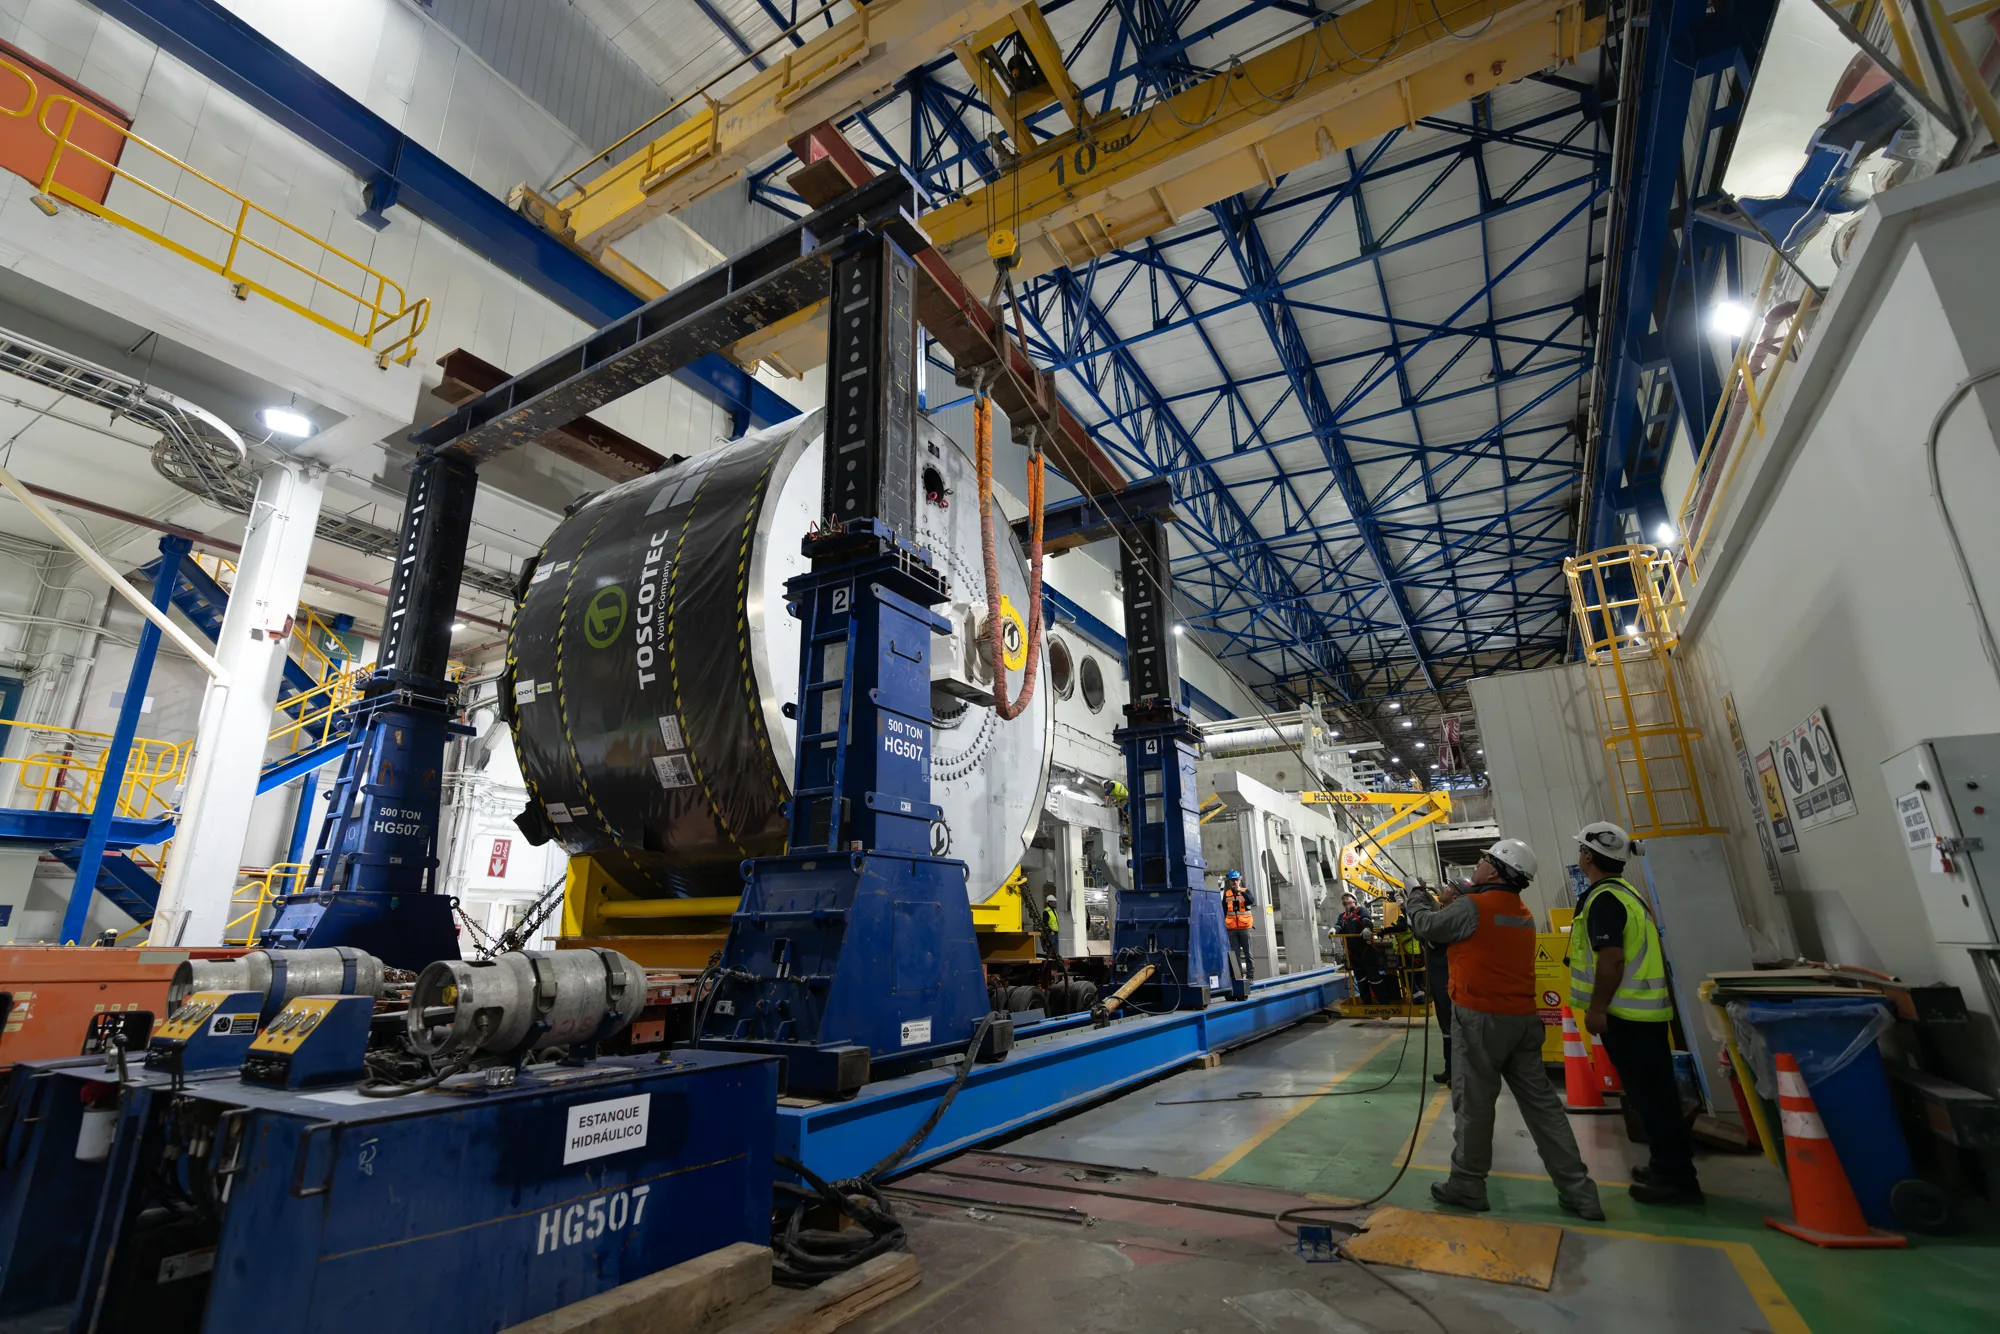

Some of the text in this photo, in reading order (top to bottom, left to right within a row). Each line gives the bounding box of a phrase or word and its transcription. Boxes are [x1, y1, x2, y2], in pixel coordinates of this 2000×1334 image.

[1048, 134, 1131, 186] 10 ton
[636, 529, 669, 690] TOSCOTEC
[657, 560, 672, 651] A Voith Company
[834, 589, 847, 610] 2
[888, 718, 923, 740] 500 TON
[884, 735, 923, 761] HG507
[1147, 740, 1156, 752] 4
[380, 807, 421, 820] 500 TON
[373, 820, 420, 836] HG507
[578, 1106, 640, 1129] ESTANQUE
[571, 1123, 643, 1150] HIDRÁULICO
[537, 1184, 650, 1255] HG507
